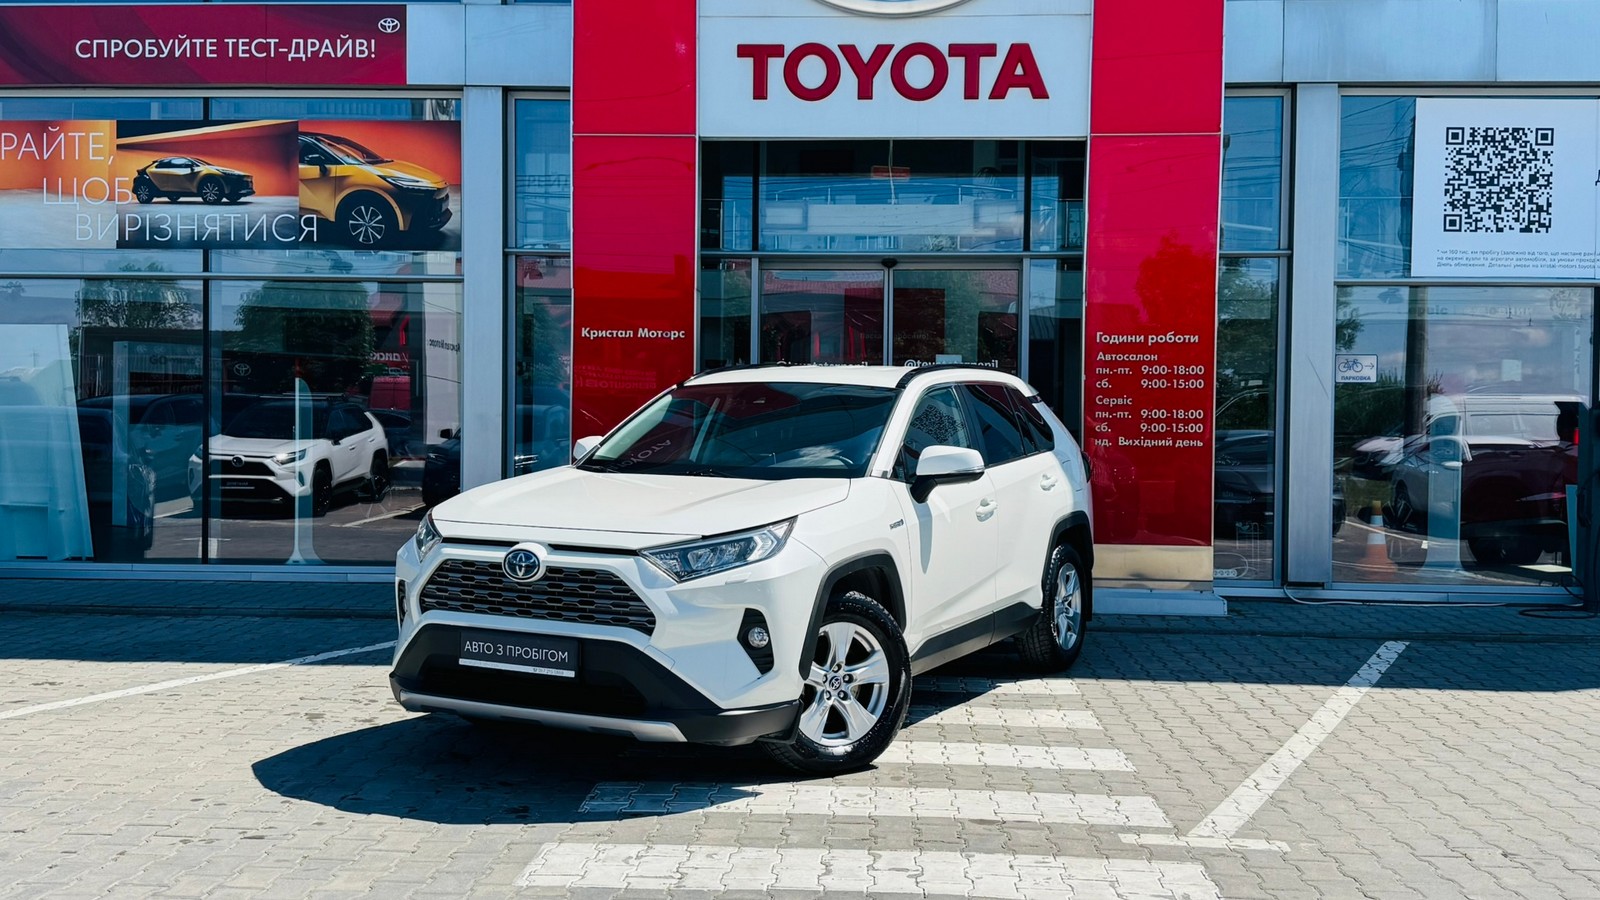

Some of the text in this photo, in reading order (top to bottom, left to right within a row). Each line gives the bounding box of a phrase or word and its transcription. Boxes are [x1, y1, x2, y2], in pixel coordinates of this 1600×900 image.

[75, 34, 376, 61] СПРОБУЙТЕ ТЕСТ-ДРАЙВ!
[736, 41, 1050, 102] TOYOTA
[43, 177, 132, 209] ЩОБ
[75, 213, 318, 242] ВИРІЗНЯТИСЯ
[581, 326, 686, 340] Кристал Моторс
[1096, 331, 1199, 346] Години роботи
[1096, 352, 1158, 361] Автосалон
[1096, 365, 1204, 375] пн.-пт. 9:00-18:00
[1096, 378, 1204, 389] сб. 9:00-15:00
[1095, 394, 1133, 407] Сервіс
[1095, 409, 1203, 419] пн.-пт. 9:00-18:00
[1095, 422, 1203, 433] сб. 9:00-15:00
[1095, 436, 1203, 448] нд. Вихідний день
[464, 640, 494, 654] АВТО
[506, 645, 569, 663] ПРОБІГОМ
